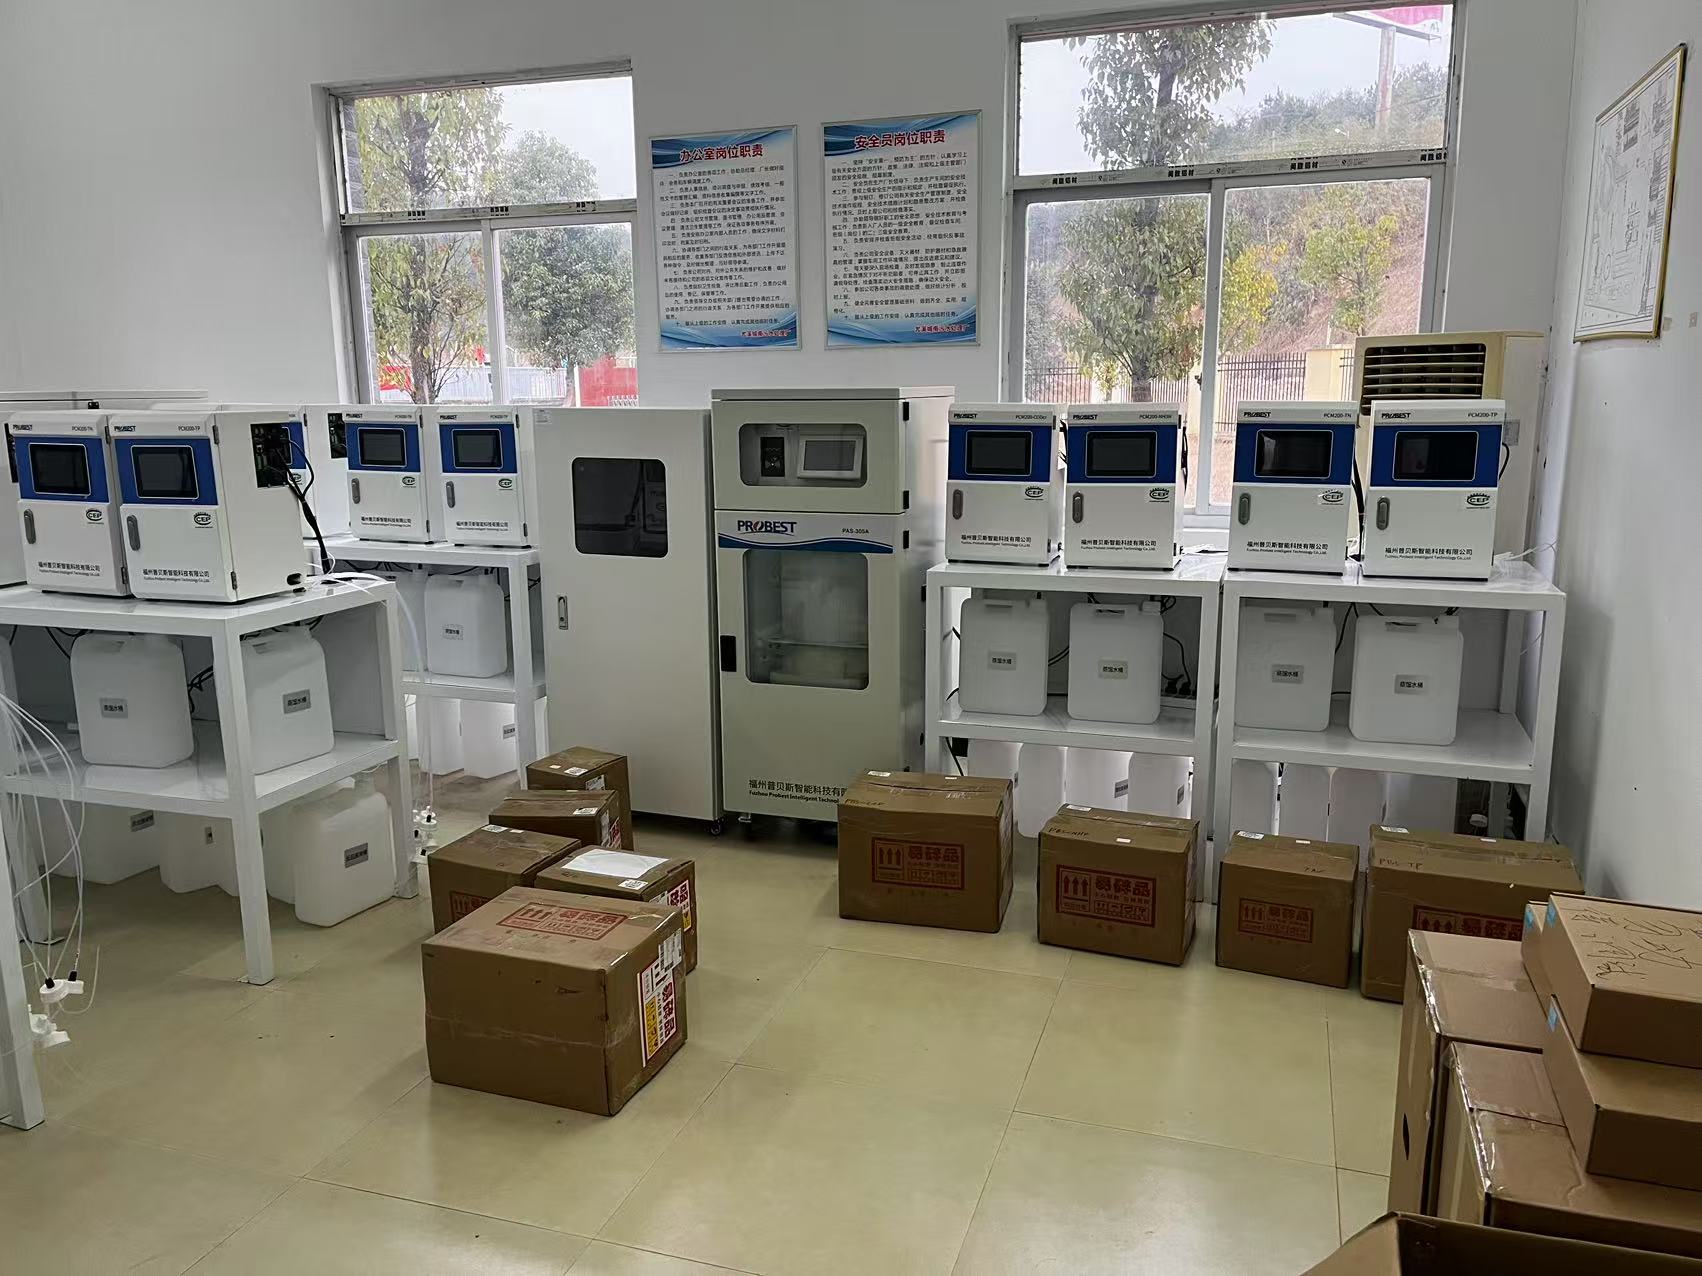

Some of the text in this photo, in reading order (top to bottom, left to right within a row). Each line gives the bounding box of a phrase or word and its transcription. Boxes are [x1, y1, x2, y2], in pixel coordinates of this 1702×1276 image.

[855, 130, 946, 149] 安全员岗位职责
[680, 144, 763, 161] 办公室岗位职责
[737, 519, 797, 535] PROBEST
[961, 534, 1032, 543] 福州普贝斯智能科技有限公司
[1081, 539, 1157, 547] 福州普贝斯智能科技有限公司
[1247, 541, 1329, 550] 福州普贝斯智能科技有限公司
[1385, 547, 1473, 556] 福州普贝斯智能科技有限公司
[143, 569, 210, 578] 福州普贝斯智能科技有限公司
[768, 791, 789, 799] Probest
[789, 793, 818, 802] Intelligent
